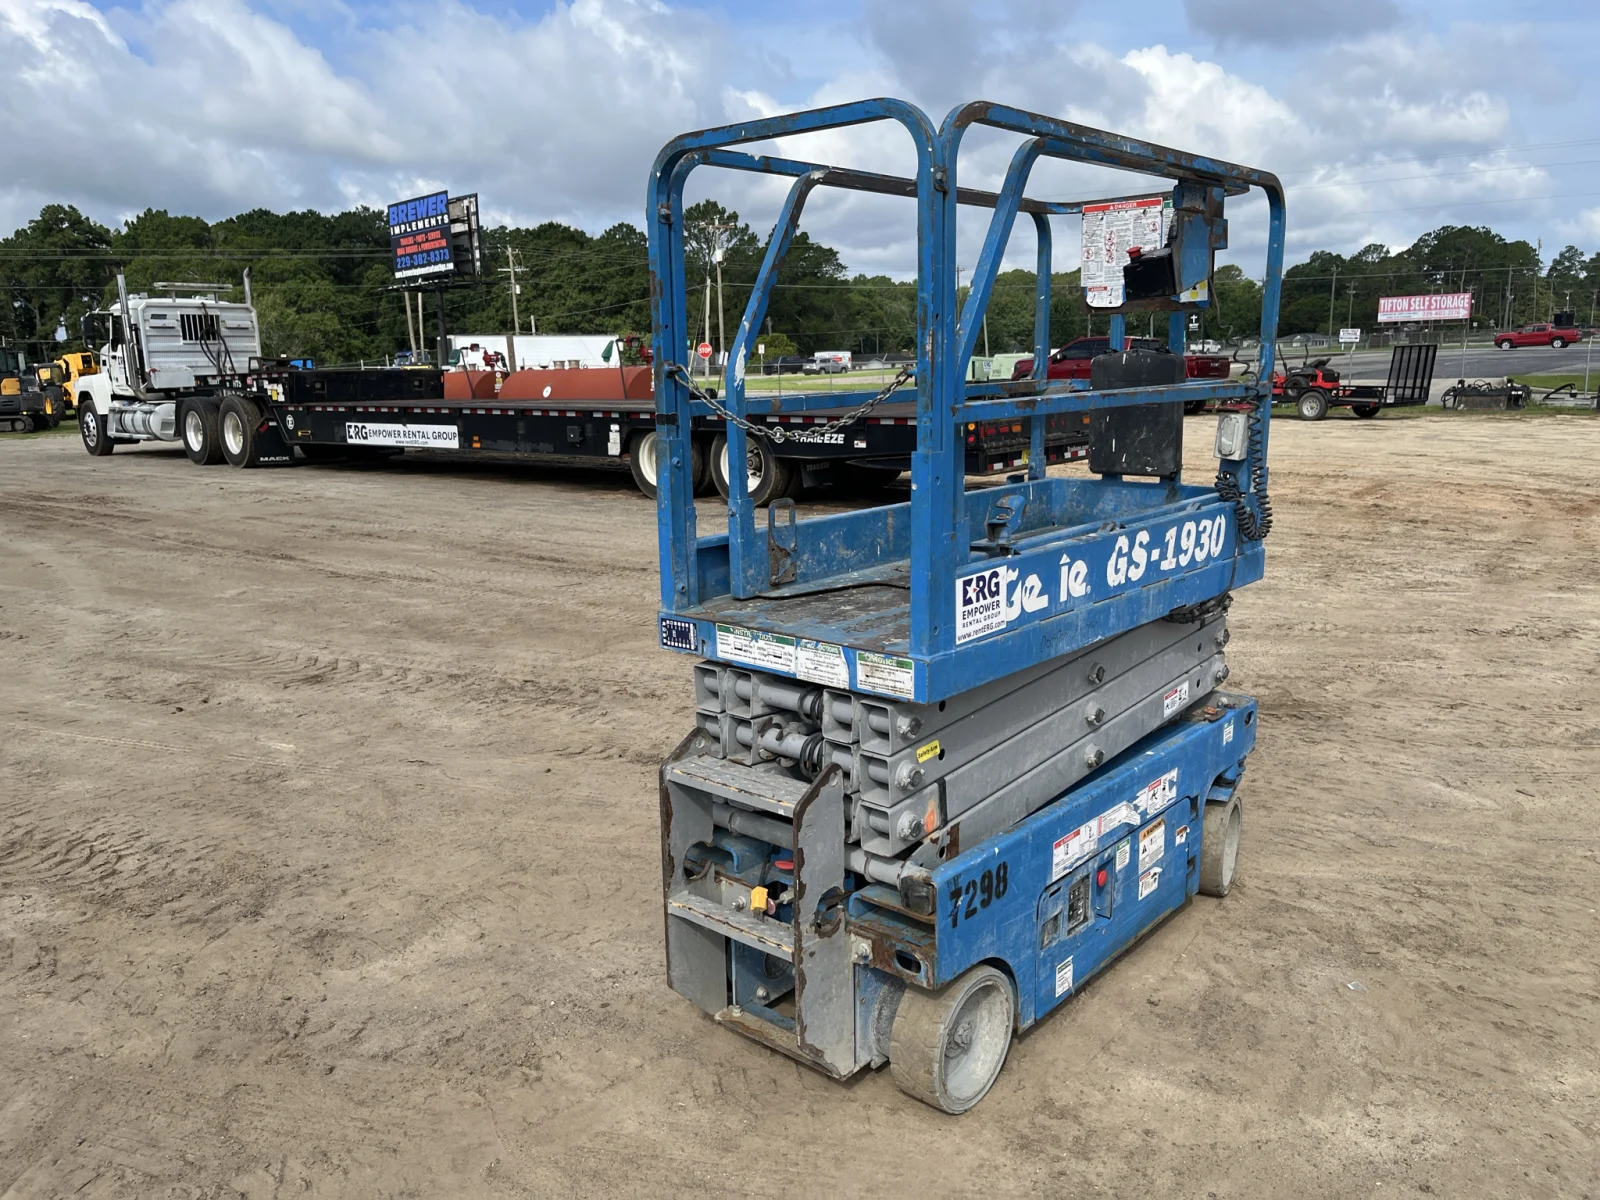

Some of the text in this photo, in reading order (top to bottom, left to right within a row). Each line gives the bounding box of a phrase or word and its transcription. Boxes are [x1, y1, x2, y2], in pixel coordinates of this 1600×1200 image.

[389, 193, 447, 226] BREWER
[1114, 202, 1137, 210] DANGER
[390, 214, 448, 236] IMPLEMENTS
[1380, 295, 1469, 312] TIFTON SELF STORAGE
[346, 424, 458, 441] ERG EMPOWER RENTAL GROUP
[1106, 514, 1226, 588] GS-1930
[962, 570, 1000, 607] ERG
[962, 600, 1001, 621] EMPOWER
[962, 610, 1001, 629] RENTAL GROUP
[957, 619, 1005, 642] www.rentERG.com
[949, 861, 1008, 929] 7298
